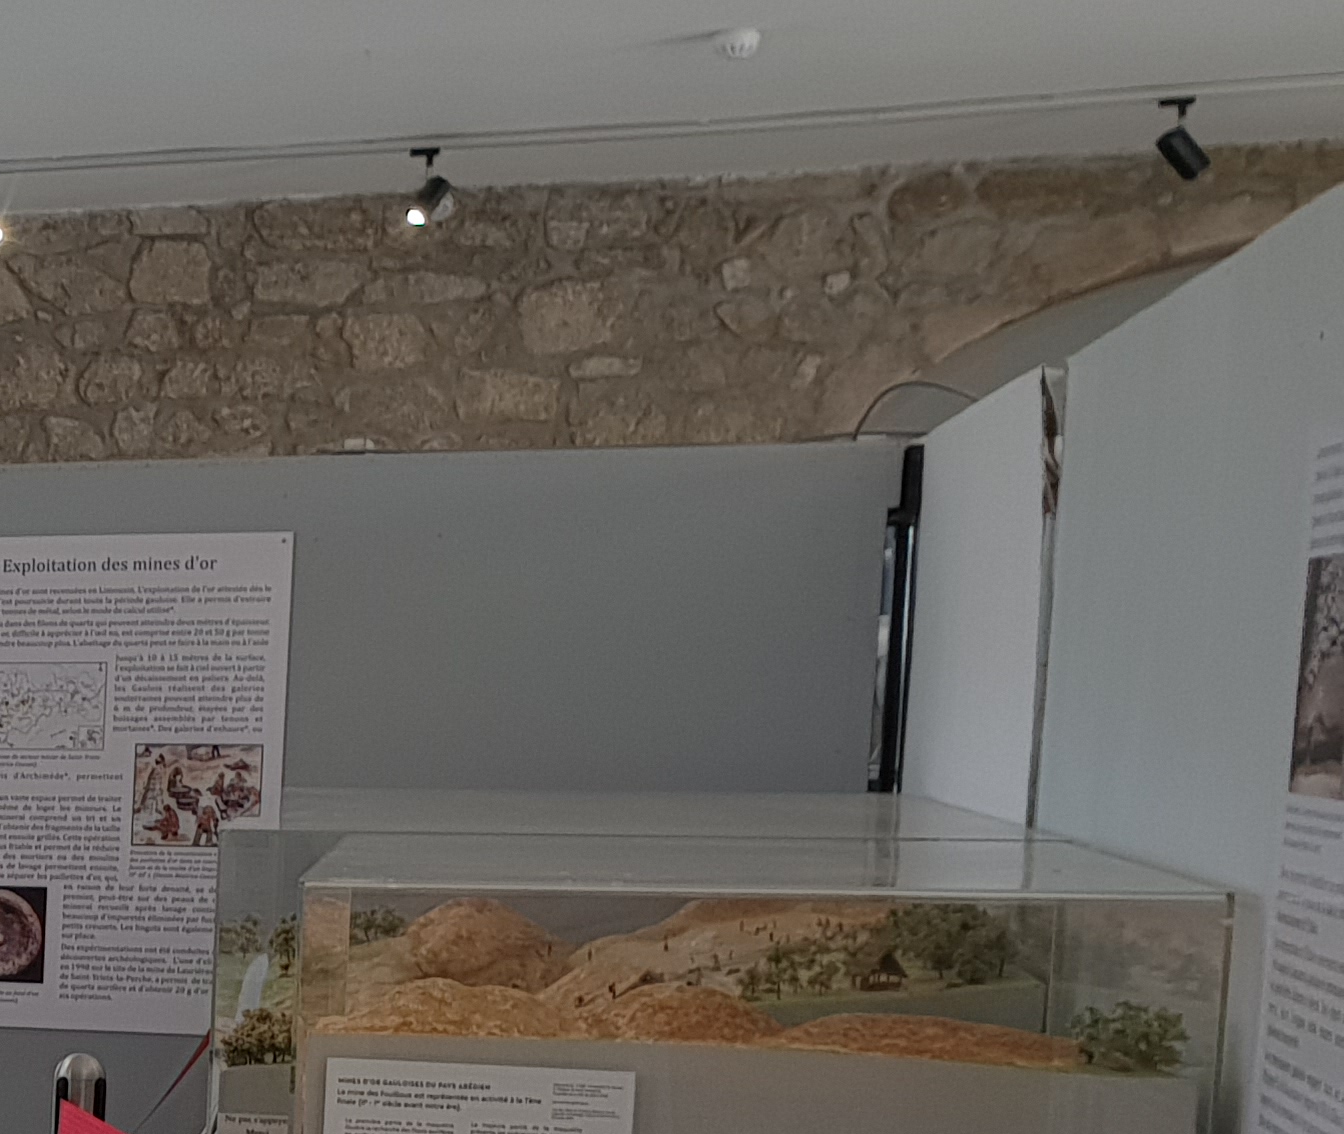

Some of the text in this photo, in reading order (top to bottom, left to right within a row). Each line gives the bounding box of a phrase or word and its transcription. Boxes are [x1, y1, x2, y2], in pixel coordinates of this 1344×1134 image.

[3, 556, 217, 576] Exploitation des mines d'or
[382, 1079, 424, 1088] GAULOISES
[438, 1081, 456, 1089] PAYS
[253, 1116, 288, 1126] s'appuye
